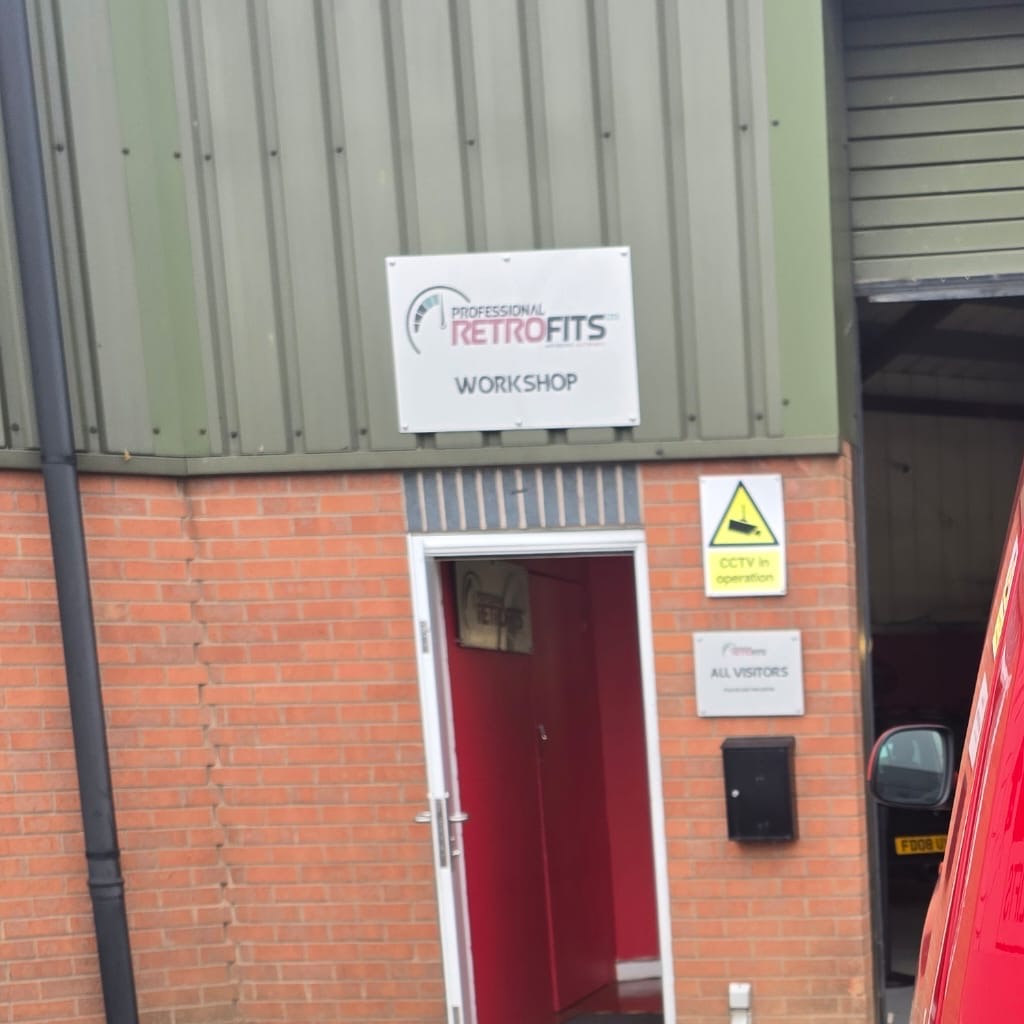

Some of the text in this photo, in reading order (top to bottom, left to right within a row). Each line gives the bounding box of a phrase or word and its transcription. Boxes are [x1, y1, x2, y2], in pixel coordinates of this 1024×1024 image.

[451, 304, 546, 319] PROFESSIONAL
[451, 314, 607, 346] RETROFITS
[454, 373, 578, 395] WORKSHOP
[719, 557, 770, 569] CCTV in
[716, 573, 774, 585] operation
[710, 666, 789, 679] ALL VISITORS
